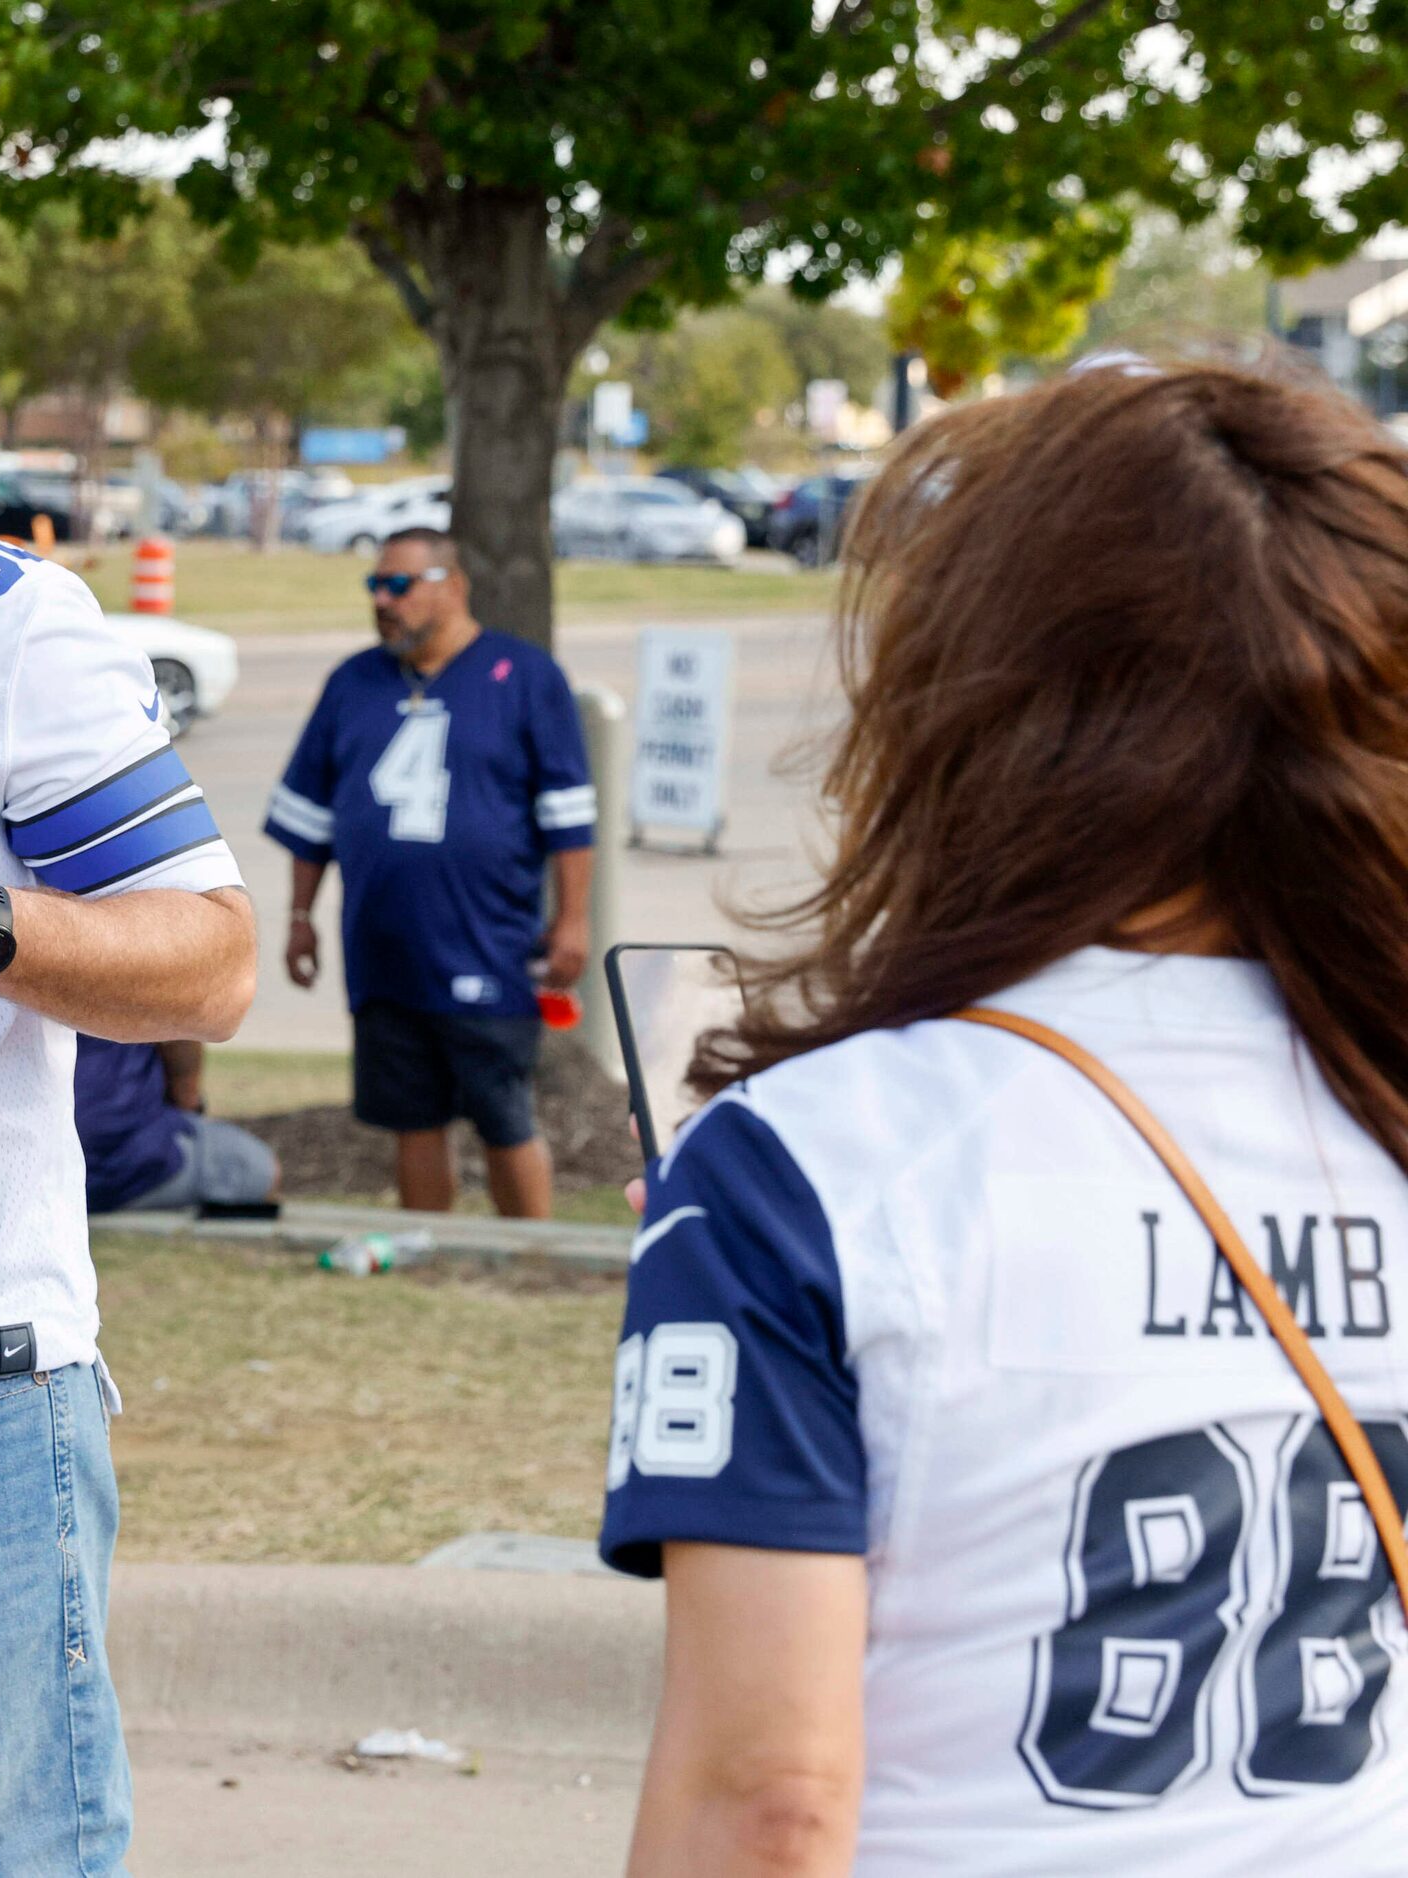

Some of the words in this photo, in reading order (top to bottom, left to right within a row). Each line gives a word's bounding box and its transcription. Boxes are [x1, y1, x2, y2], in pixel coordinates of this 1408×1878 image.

[368, 710, 452, 843] 4
[1141, 1211, 1390, 1337] LAMB
[1018, 1412, 1408, 1811] 88
